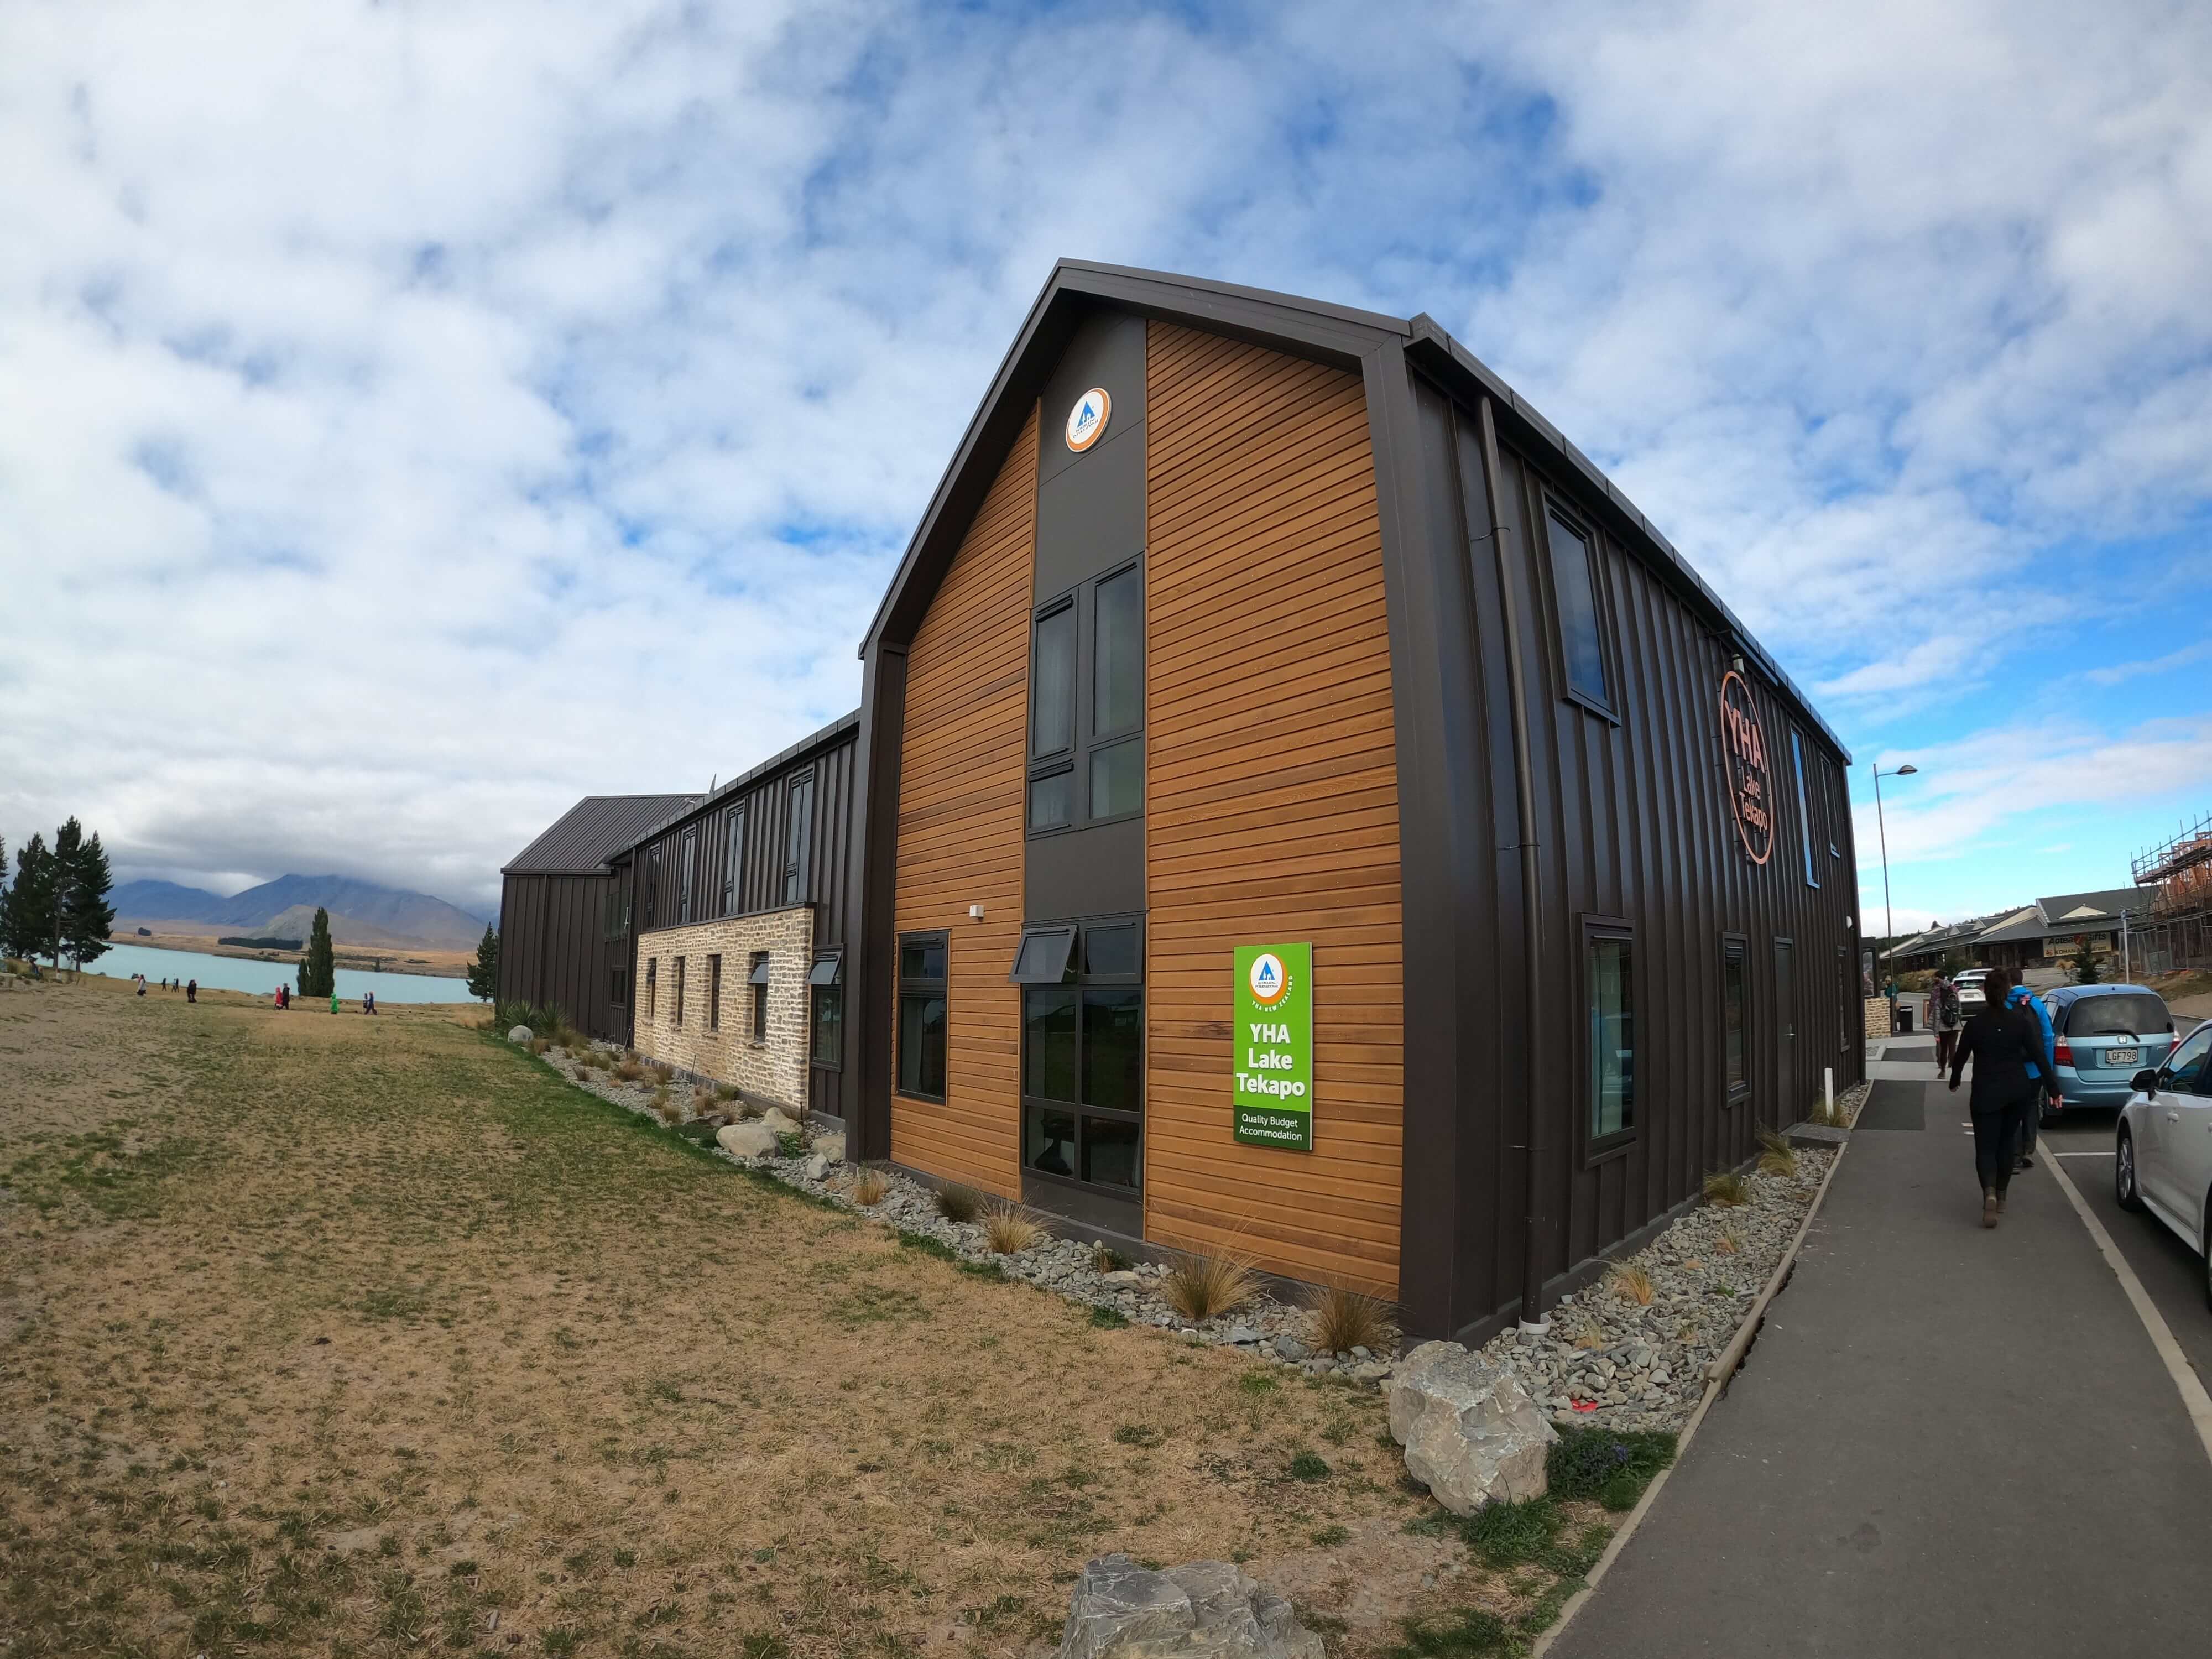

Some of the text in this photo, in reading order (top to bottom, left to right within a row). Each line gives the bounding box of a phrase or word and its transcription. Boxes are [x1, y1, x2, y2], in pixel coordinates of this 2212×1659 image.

[1724, 700, 1765, 774] YHA
[1741, 765, 1761, 800] Lake
[1739, 791, 1768, 833] Tekapo
[2048, 937, 2073, 945] Aotea
[1251, 1000, 1262, 1011] YHA
[1278, 975, 1293, 1007] ZEALAND
[1249, 1023, 1291, 1044] YHA
[1248, 1048, 1293, 1070] Lake
[2107, 1051, 2136, 1061] LGF798
[1235, 1072, 1306, 1100] Tekapo
[1241, 1113, 1298, 1129] Quality Budget
[1239, 1125, 1302, 1141] Accommodation
